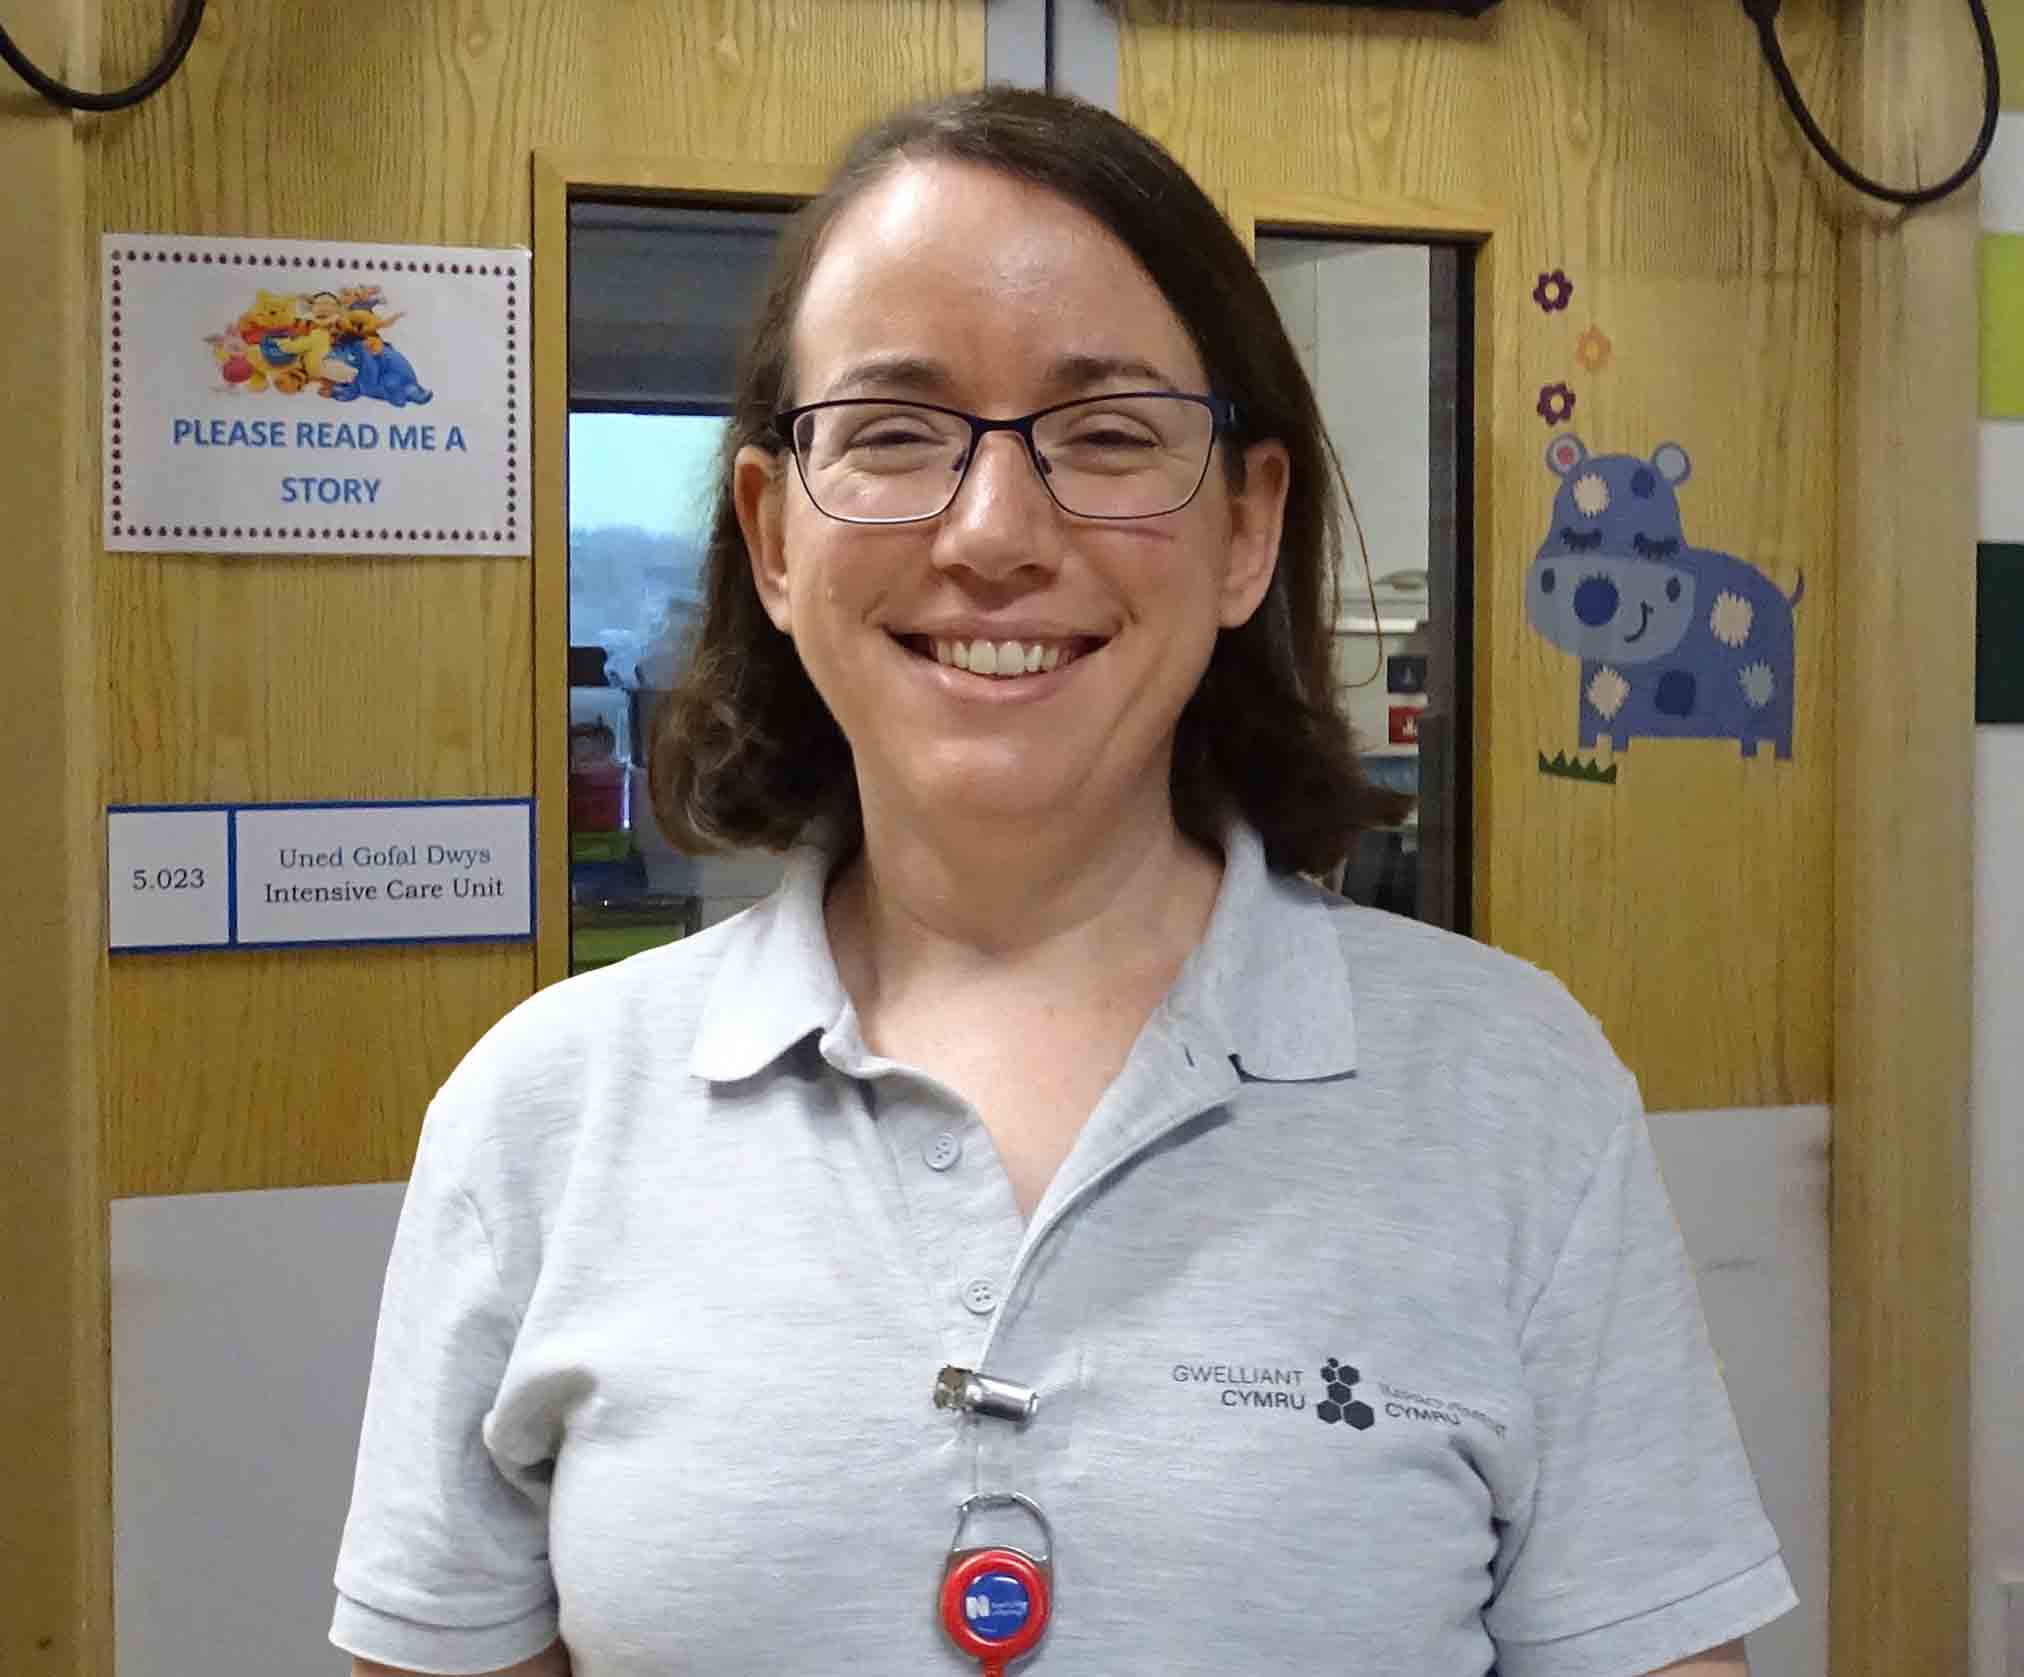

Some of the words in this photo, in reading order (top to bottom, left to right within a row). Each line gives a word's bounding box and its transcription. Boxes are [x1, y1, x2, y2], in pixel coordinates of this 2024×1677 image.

[172, 419, 287, 447] PLEASE
[296, 422, 379, 450] READ
[388, 425, 437, 451] ME
[445, 427, 467, 451] A
[280, 477, 382, 504] STORY
[278, 848, 343, 868] Uned
[352, 845, 417, 867] Gofal
[426, 844, 492, 869] Dwys
[132, 868, 206, 891] 5.023
[264, 881, 378, 904] Intensive
[385, 879, 444, 900] Care
[452, 877, 505, 898] Unit
[1172, 1364, 1305, 1386] GWELLIANT
[1221, 1389, 1307, 1411] CYMRU
